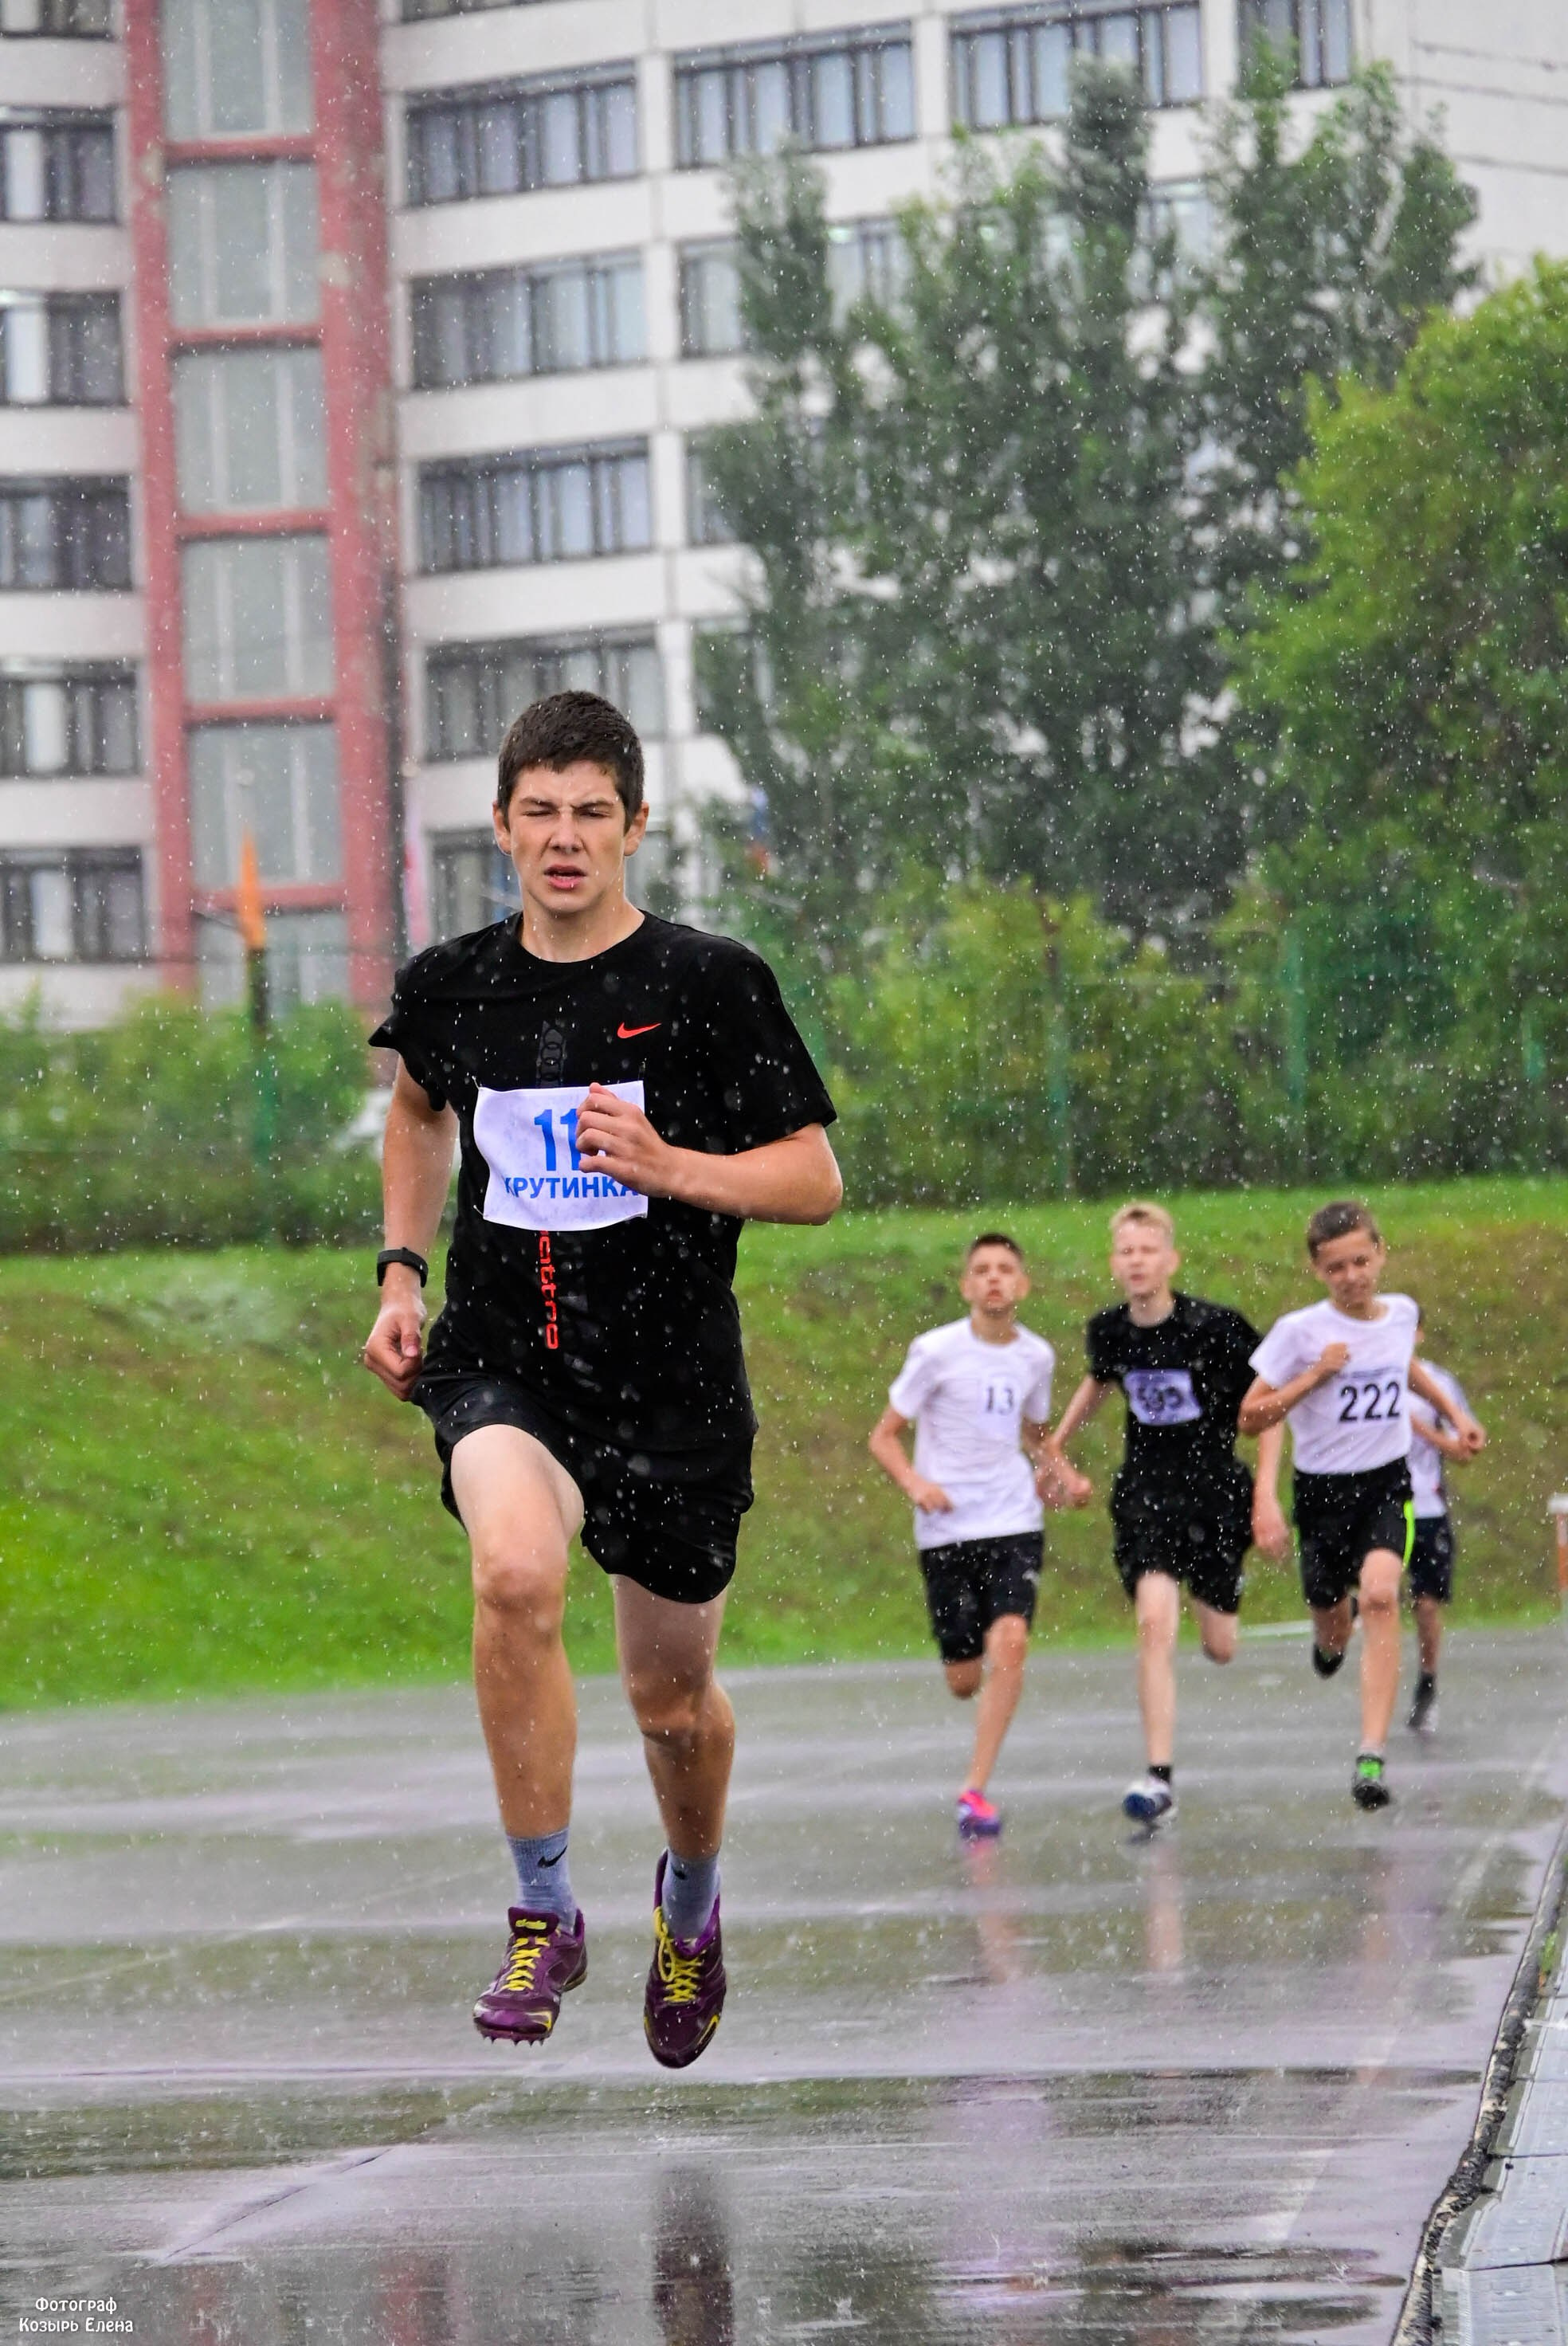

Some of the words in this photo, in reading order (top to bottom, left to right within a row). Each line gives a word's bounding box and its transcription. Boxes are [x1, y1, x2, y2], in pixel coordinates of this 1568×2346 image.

[539, 1230, 559, 1349] attro
[986, 1386, 1013, 1416] 13
[1339, 1381, 1401, 1422] 222
